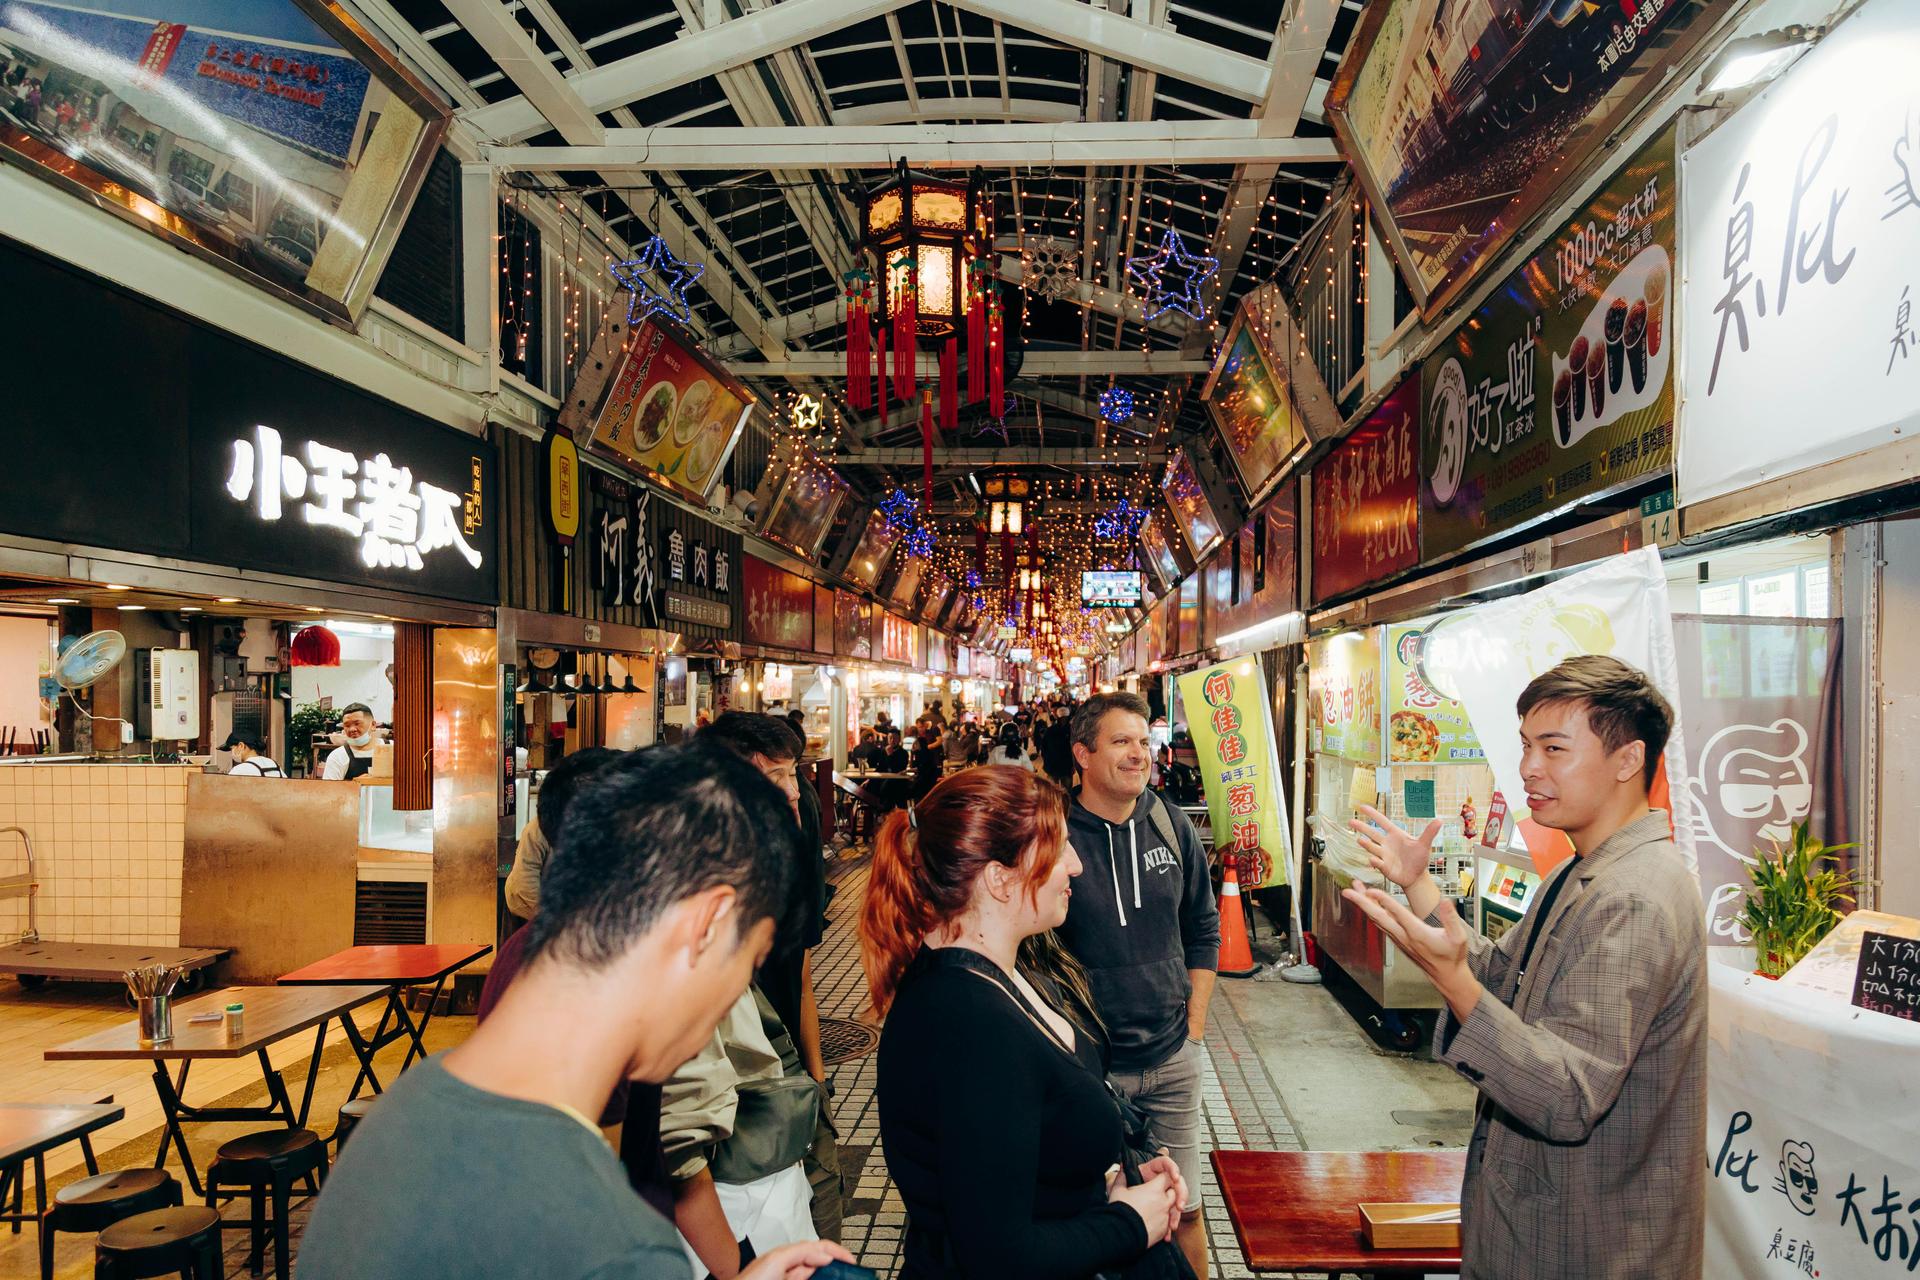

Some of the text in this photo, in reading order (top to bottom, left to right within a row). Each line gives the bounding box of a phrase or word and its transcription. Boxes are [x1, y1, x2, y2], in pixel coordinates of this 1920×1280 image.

[1556, 176, 1658, 291] 1000cc超大杯
[1467, 320, 1536, 453] 好了啦
[226, 424, 483, 571] 小王煮瓜
[1651, 515, 1670, 544] 14
[668, 529, 729, 593] 魯肉飯
[1205, 671, 1246, 764] 何佳佳
[1220, 765, 1259, 784] 純手工
